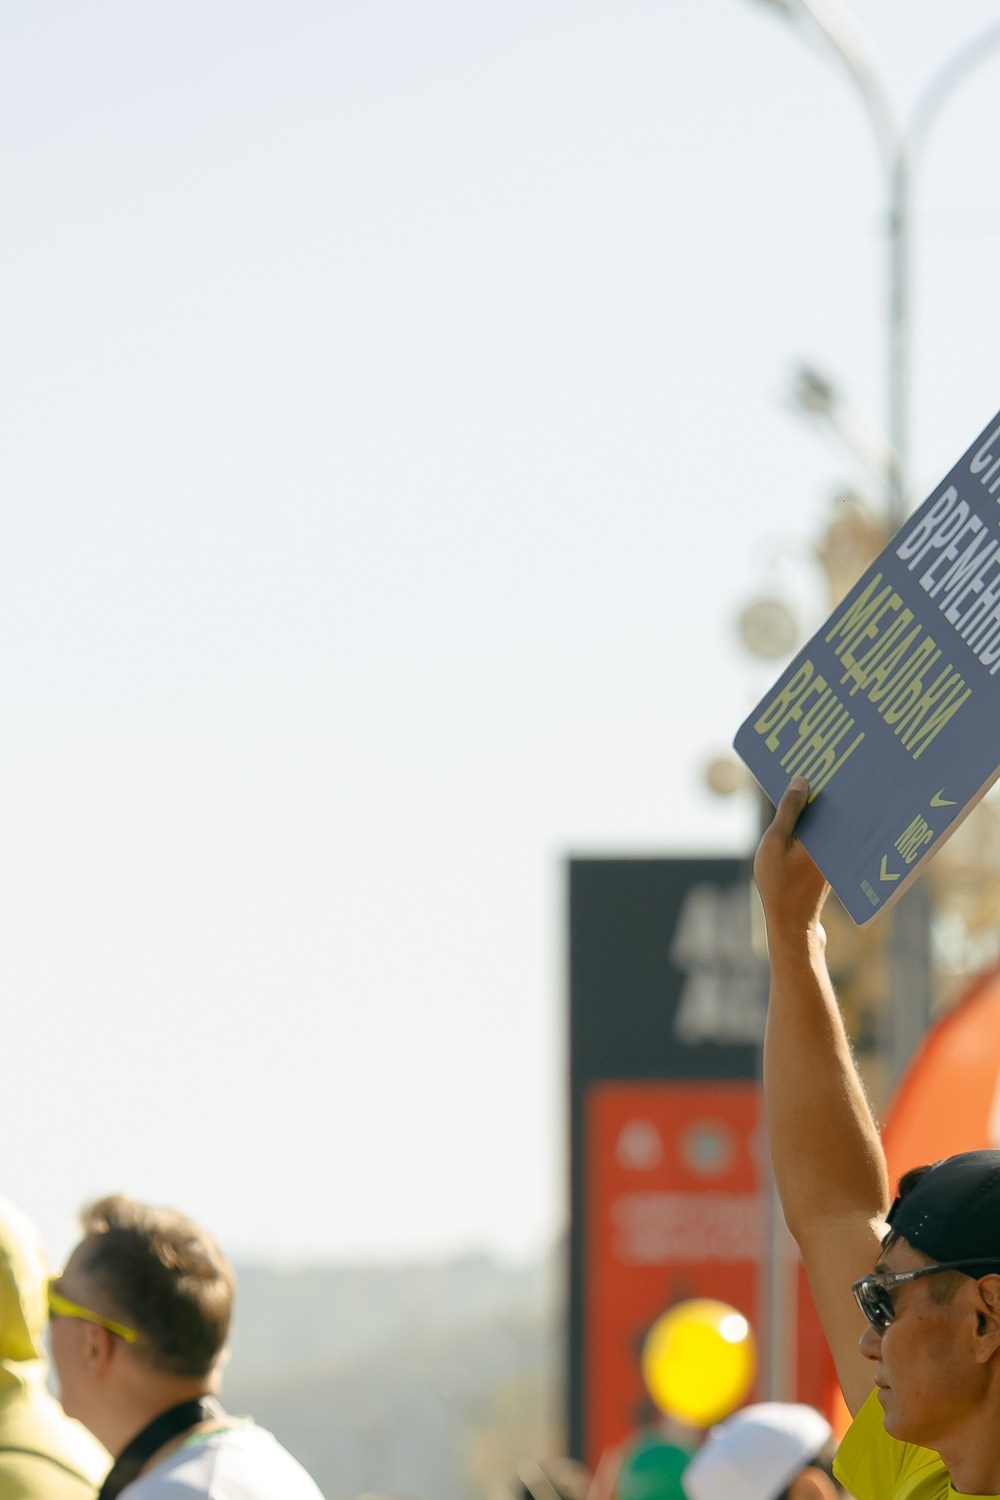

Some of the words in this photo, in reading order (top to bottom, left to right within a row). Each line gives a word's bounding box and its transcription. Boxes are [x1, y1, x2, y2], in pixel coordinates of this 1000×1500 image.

[753, 659, 866, 804] ВЕЧНЫ
[825, 572, 972, 760] МЕДАЛЬКИ
[893, 813, 934, 865] NRC
